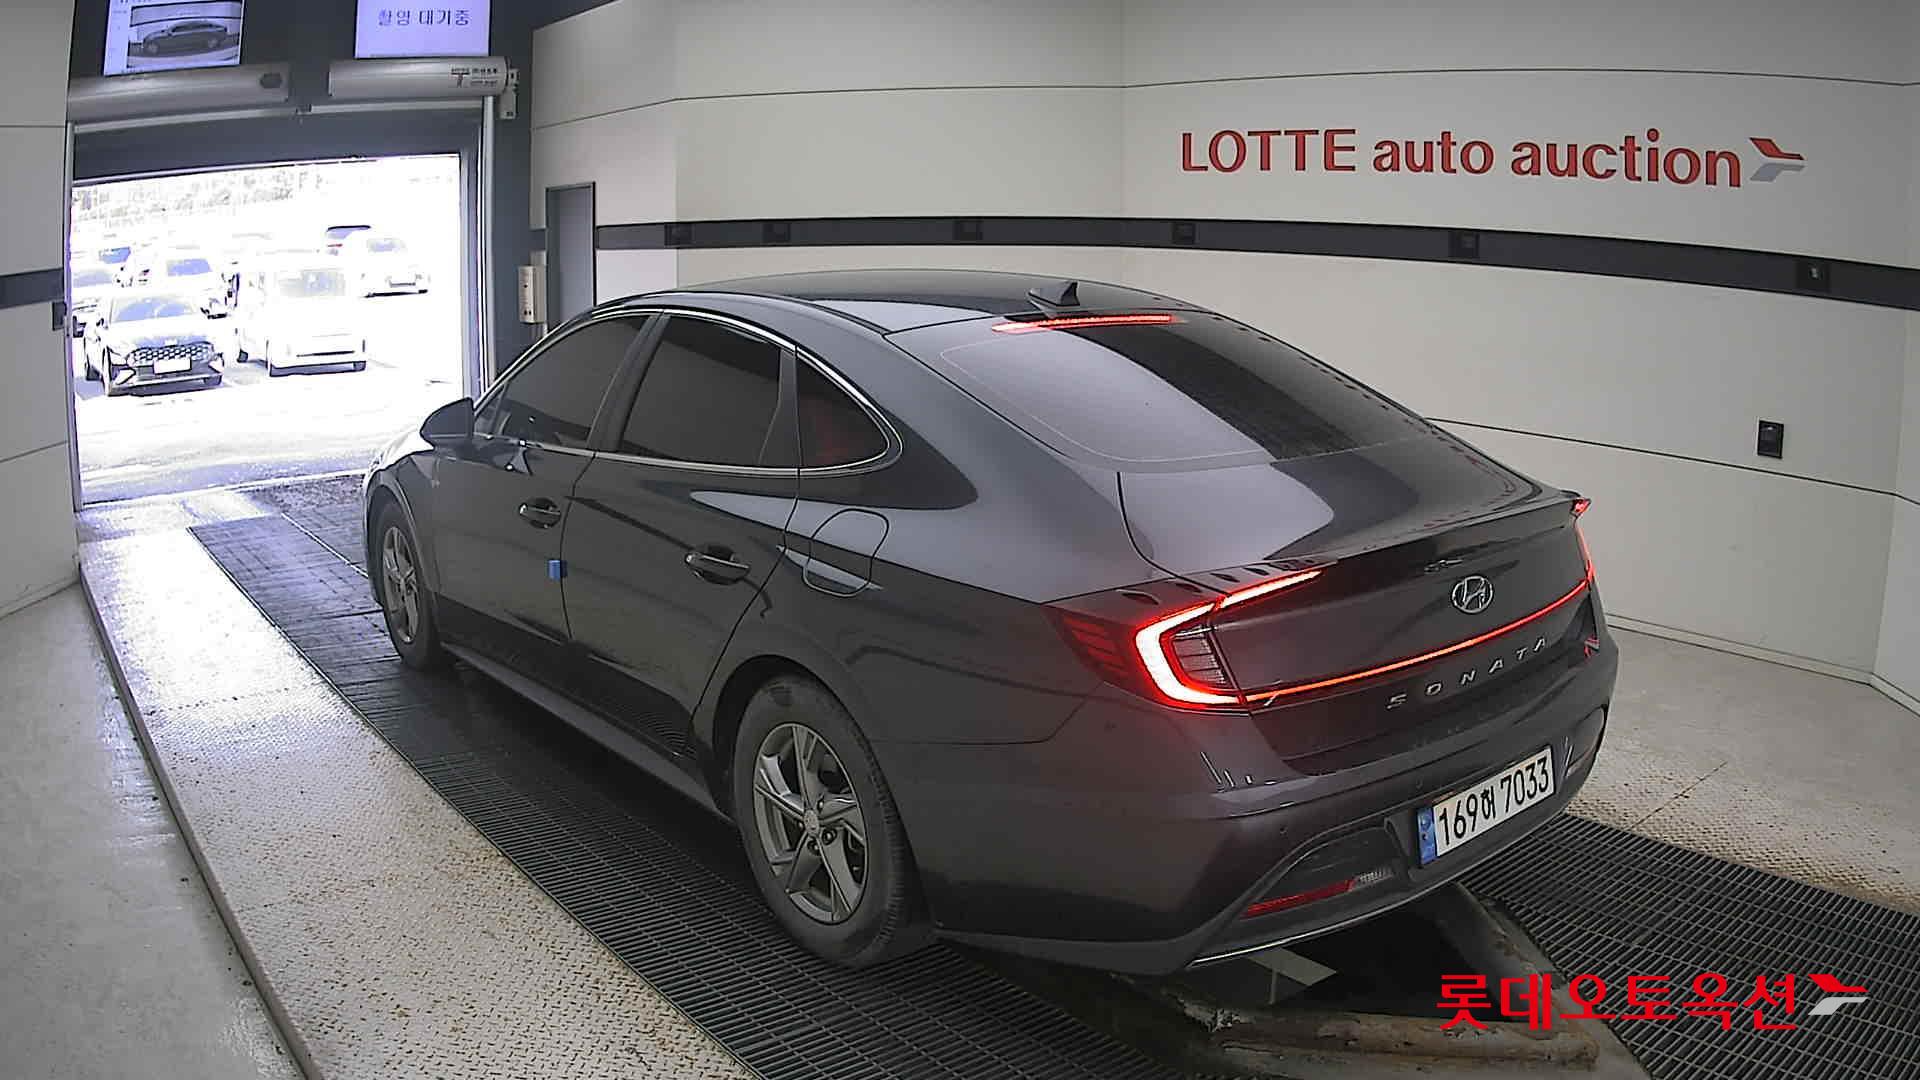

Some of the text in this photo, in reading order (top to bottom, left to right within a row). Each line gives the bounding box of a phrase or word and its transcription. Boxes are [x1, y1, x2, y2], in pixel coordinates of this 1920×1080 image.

[419, 9, 470, 26] 대기중
[1182, 128, 1741, 188] LOTTE auto auction
[1386, 636, 1547, 710] SONATA
[1438, 757, 1550, 847] 169허 7033
